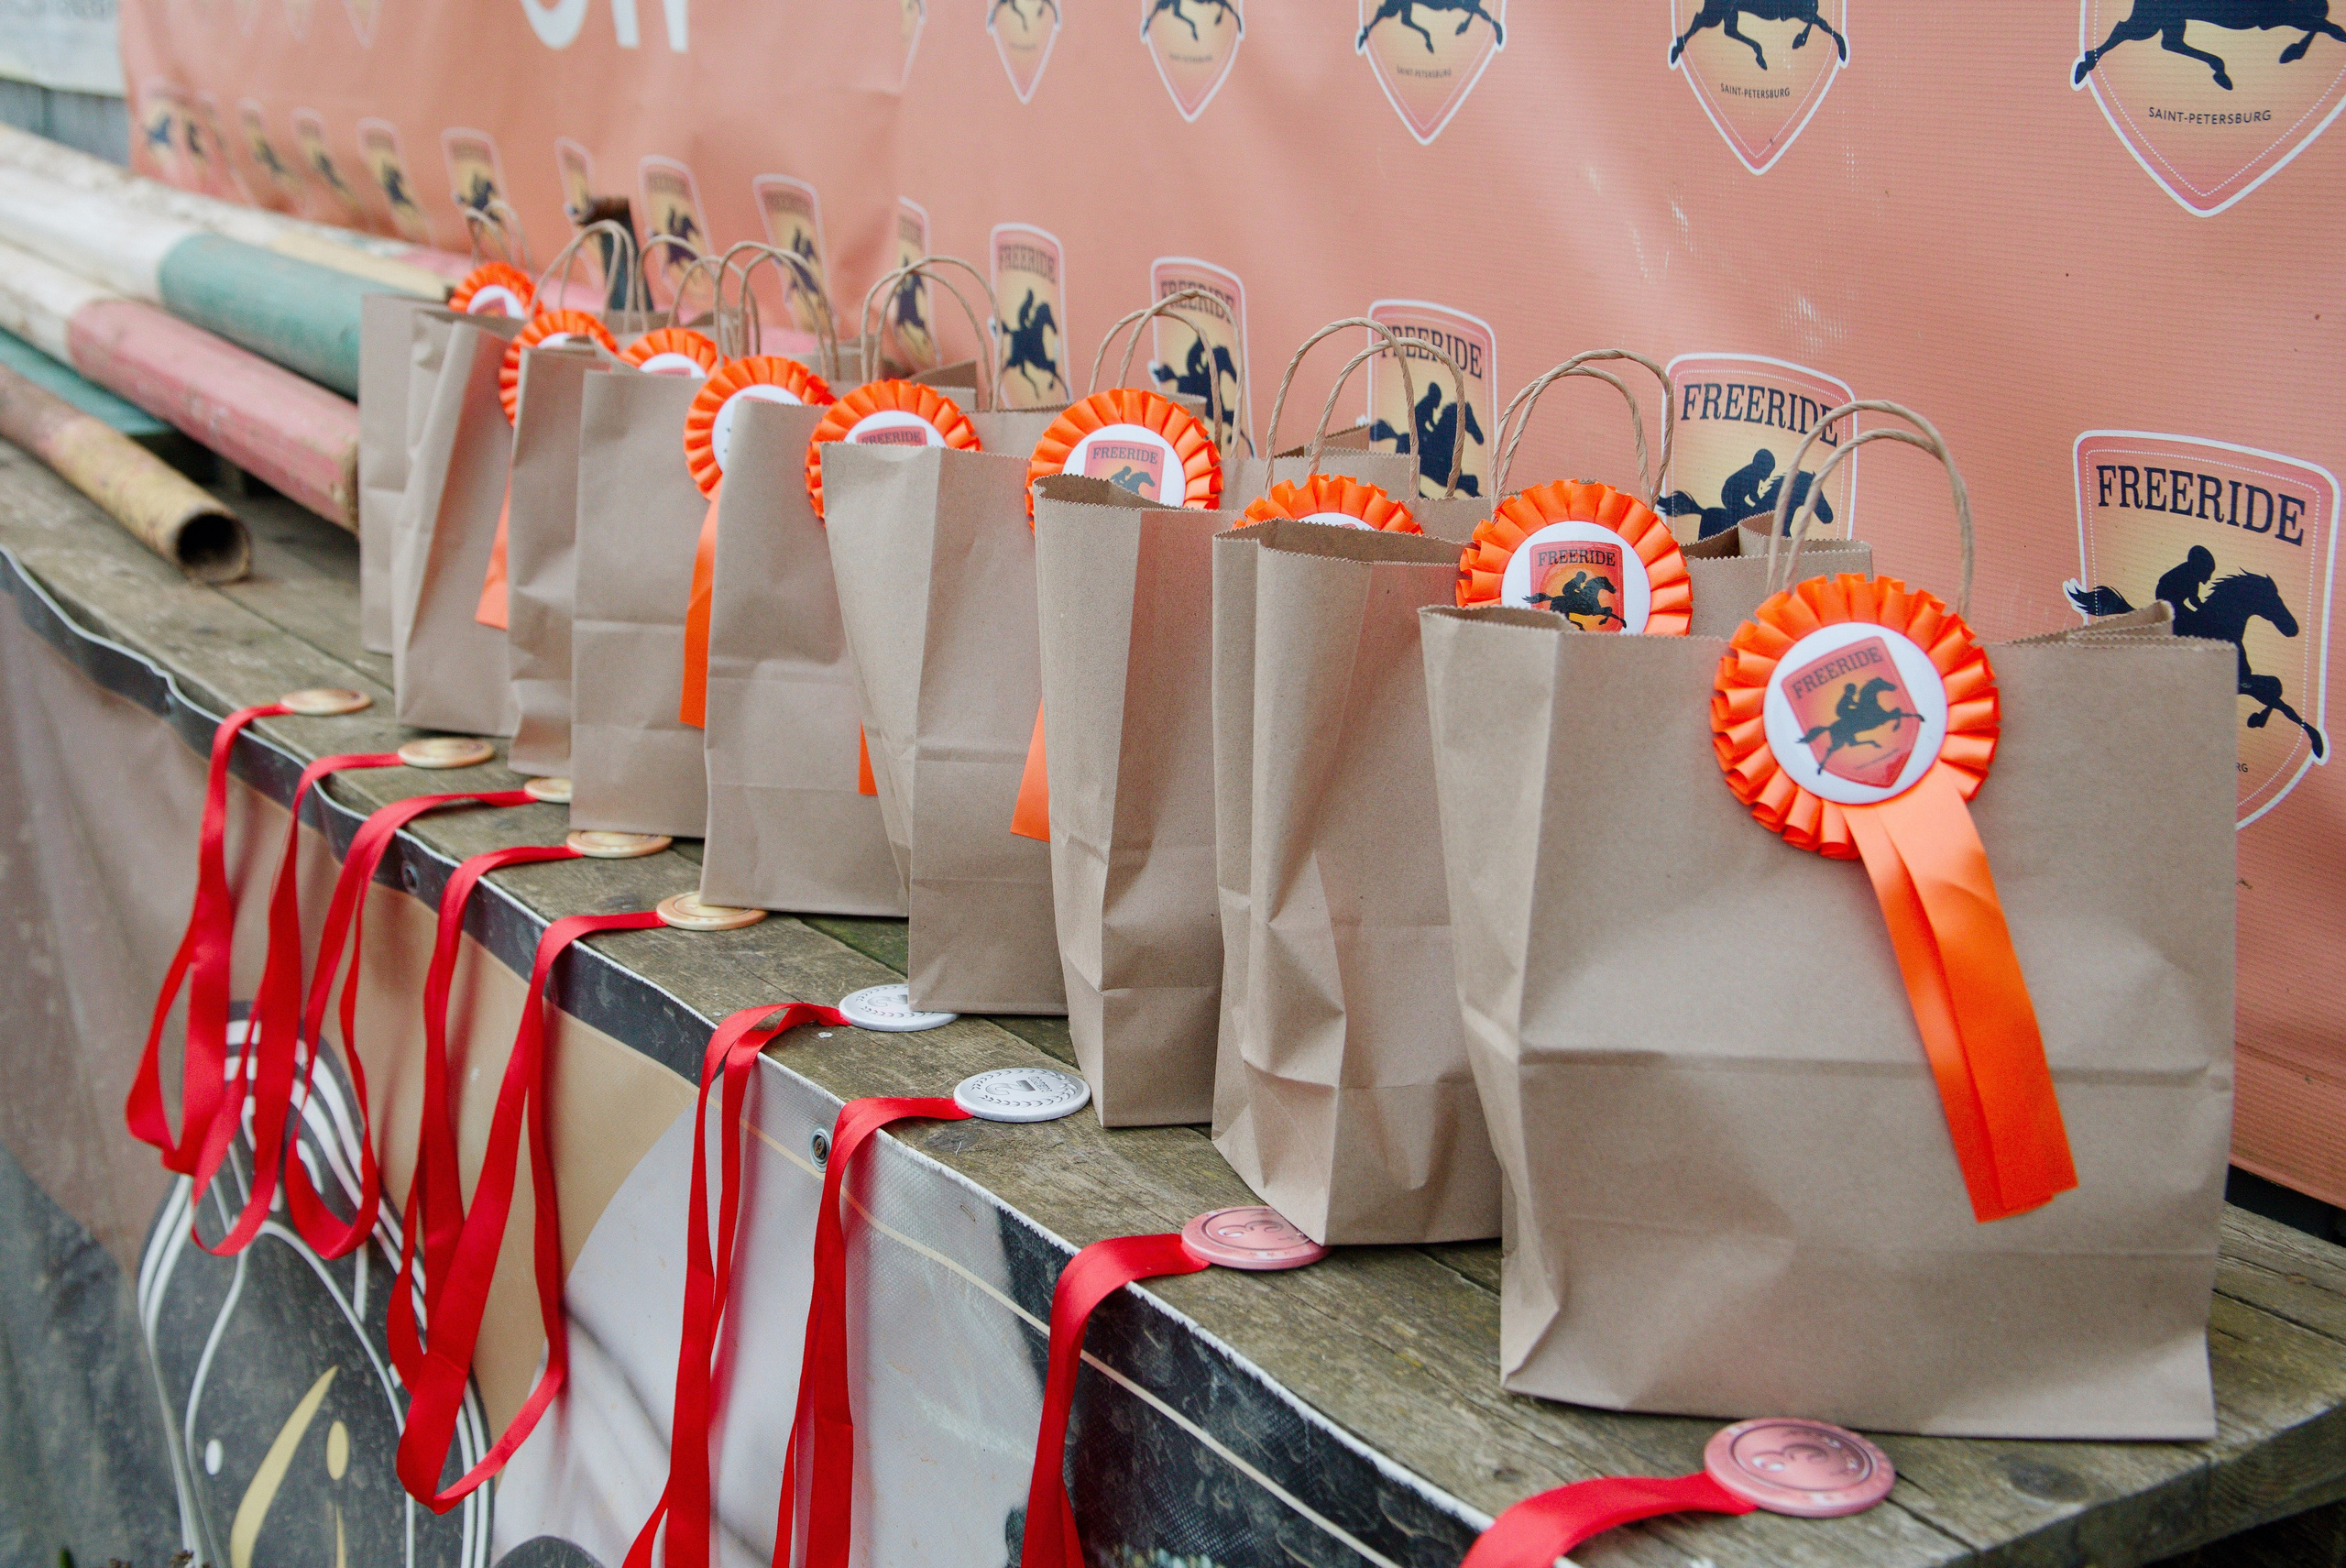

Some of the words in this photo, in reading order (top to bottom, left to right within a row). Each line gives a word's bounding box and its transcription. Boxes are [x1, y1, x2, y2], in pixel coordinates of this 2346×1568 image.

[1720, 82, 1791, 99] SAINT-PETERSBURG
[2148, 106, 2272, 125] SAINT-PETERSBURG
[1091, 446, 1159, 465] FREERIDE
[2095, 465, 2307, 547] FREERIDE
[1537, 548, 1617, 567] FREERIDE
[1792, 645, 1884, 699] FREERIDE
